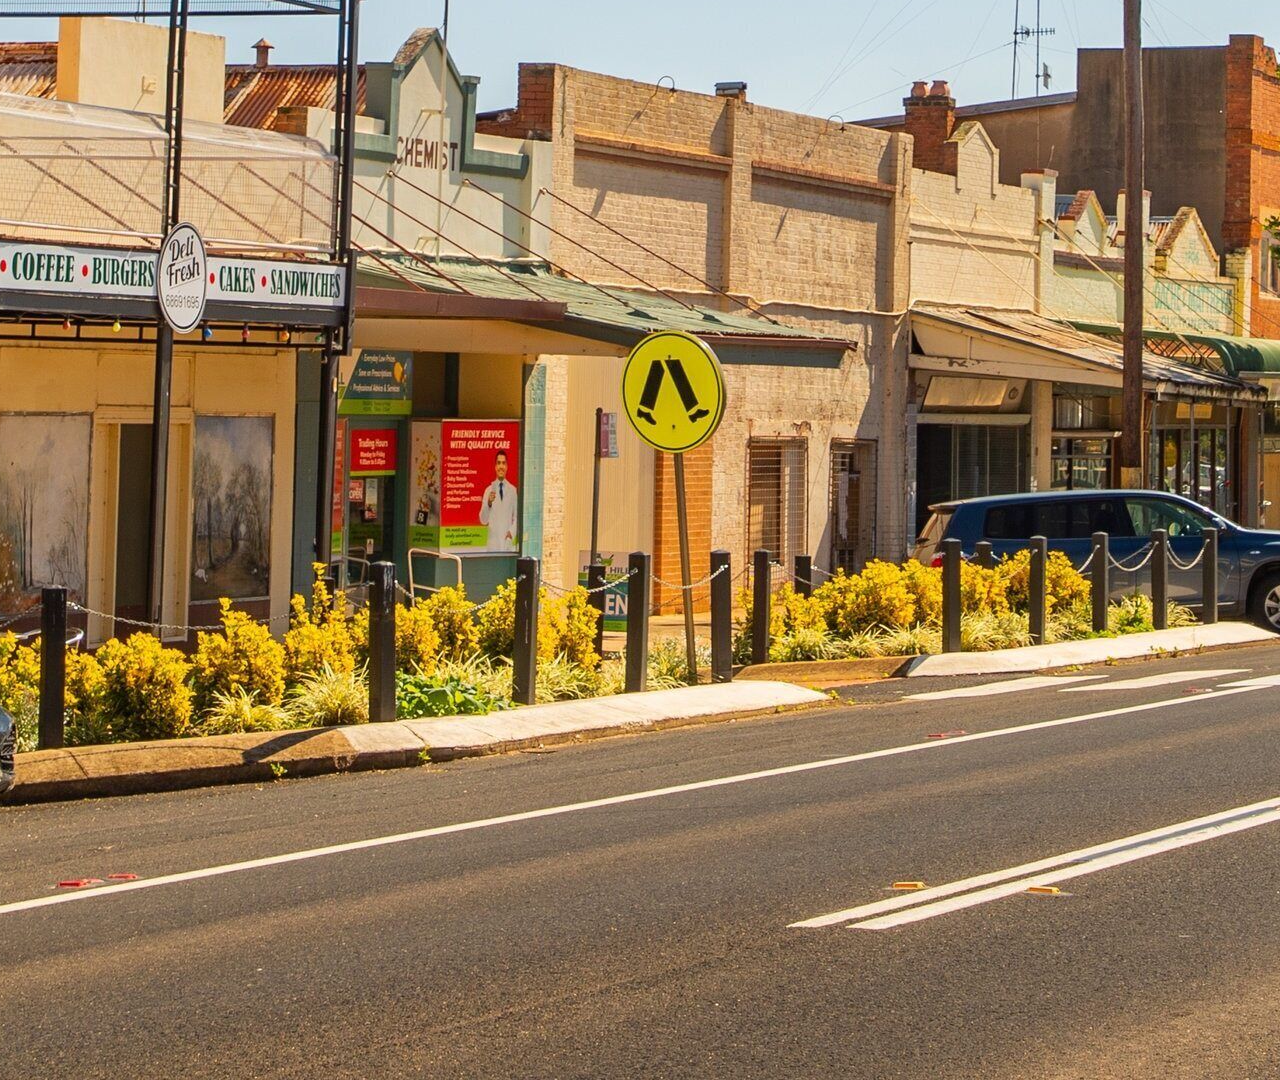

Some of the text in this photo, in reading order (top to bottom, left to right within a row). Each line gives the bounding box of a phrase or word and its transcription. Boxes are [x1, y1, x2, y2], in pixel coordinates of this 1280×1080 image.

[397, 136, 459, 171] CHEMIST
[170, 235, 194, 261] Deli
[12, 251, 155, 287] COFFEE BURGERS
[167, 257, 200, 286] Fresh
[220, 266, 341, 298] CAKES SANDWICHES
[166, 294, 200, 309] 68691695
[358, 438, 388, 449] Trading Hours
[450, 440, 510, 450] WITH QUALITY CARE
[451, 429, 505, 438] FRIENDLY SERVICE
[605, 593, 628, 615] EN
